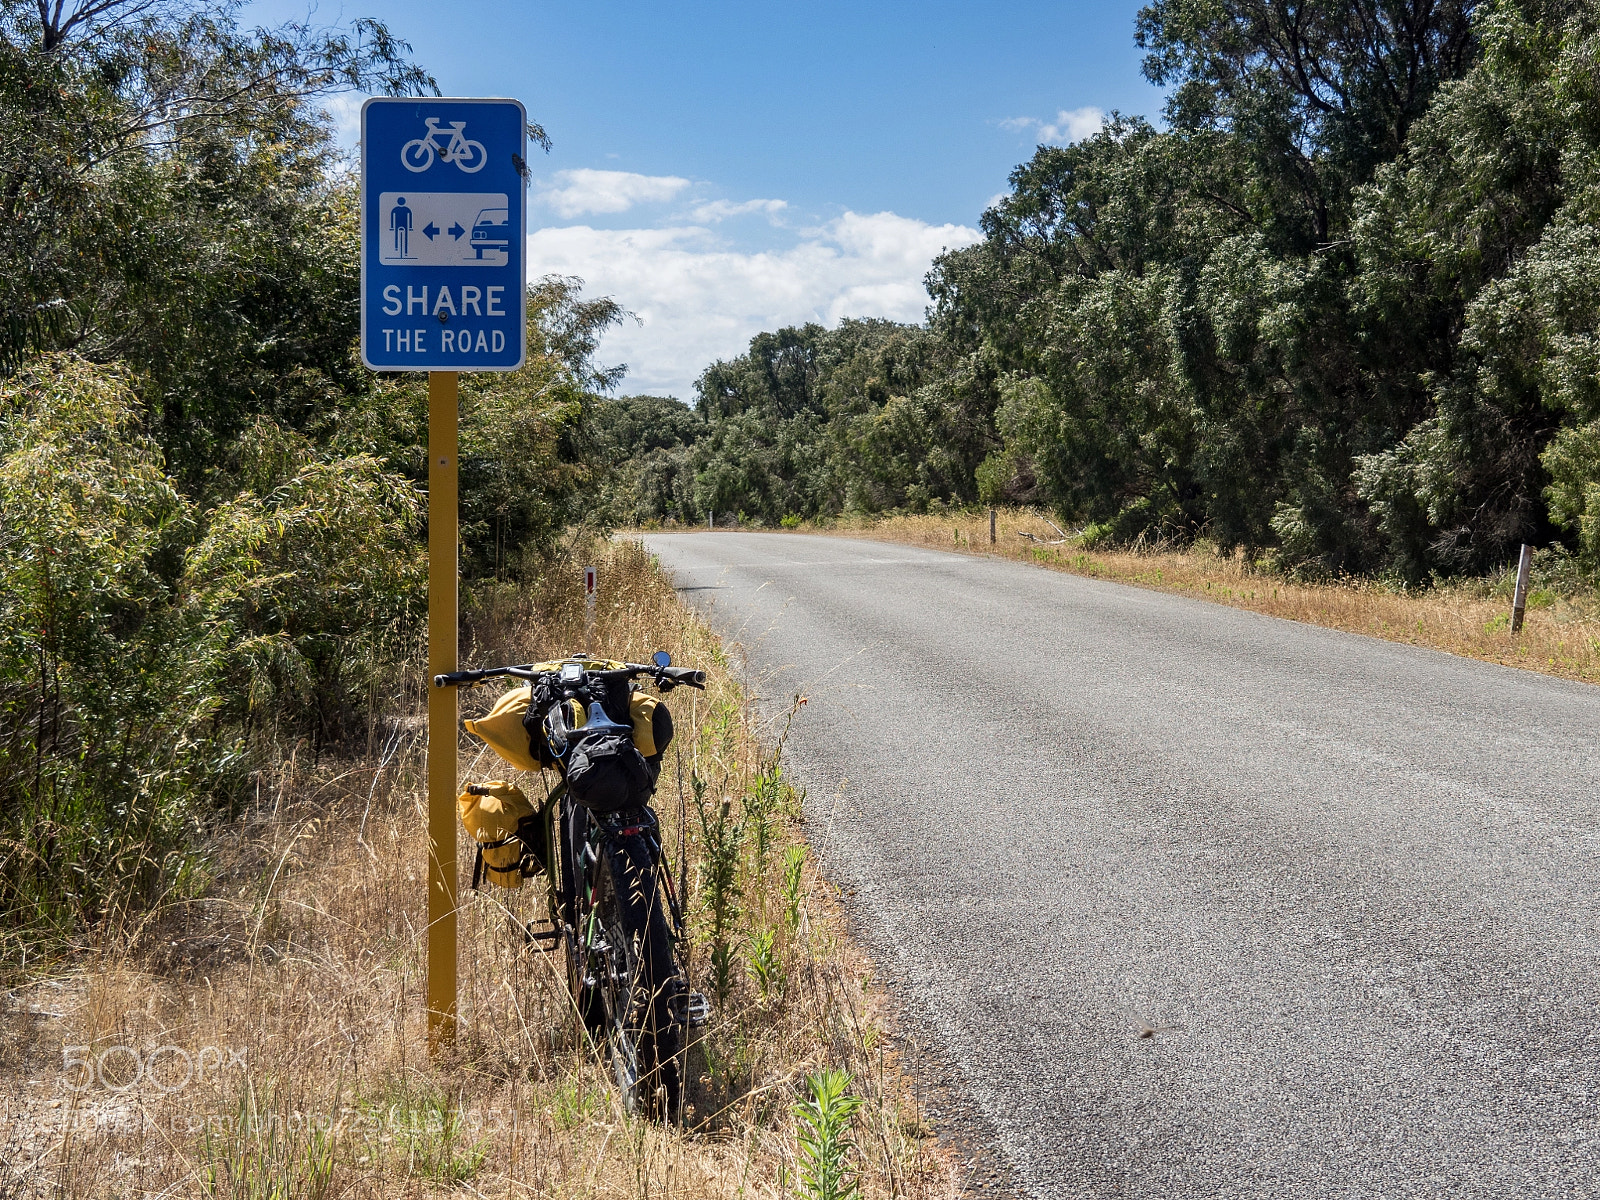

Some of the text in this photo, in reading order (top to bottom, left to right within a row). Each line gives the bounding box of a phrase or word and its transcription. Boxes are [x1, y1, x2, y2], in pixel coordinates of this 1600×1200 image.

[382, 284, 506, 316] SHARE
[382, 329, 506, 353] THE ROAD
